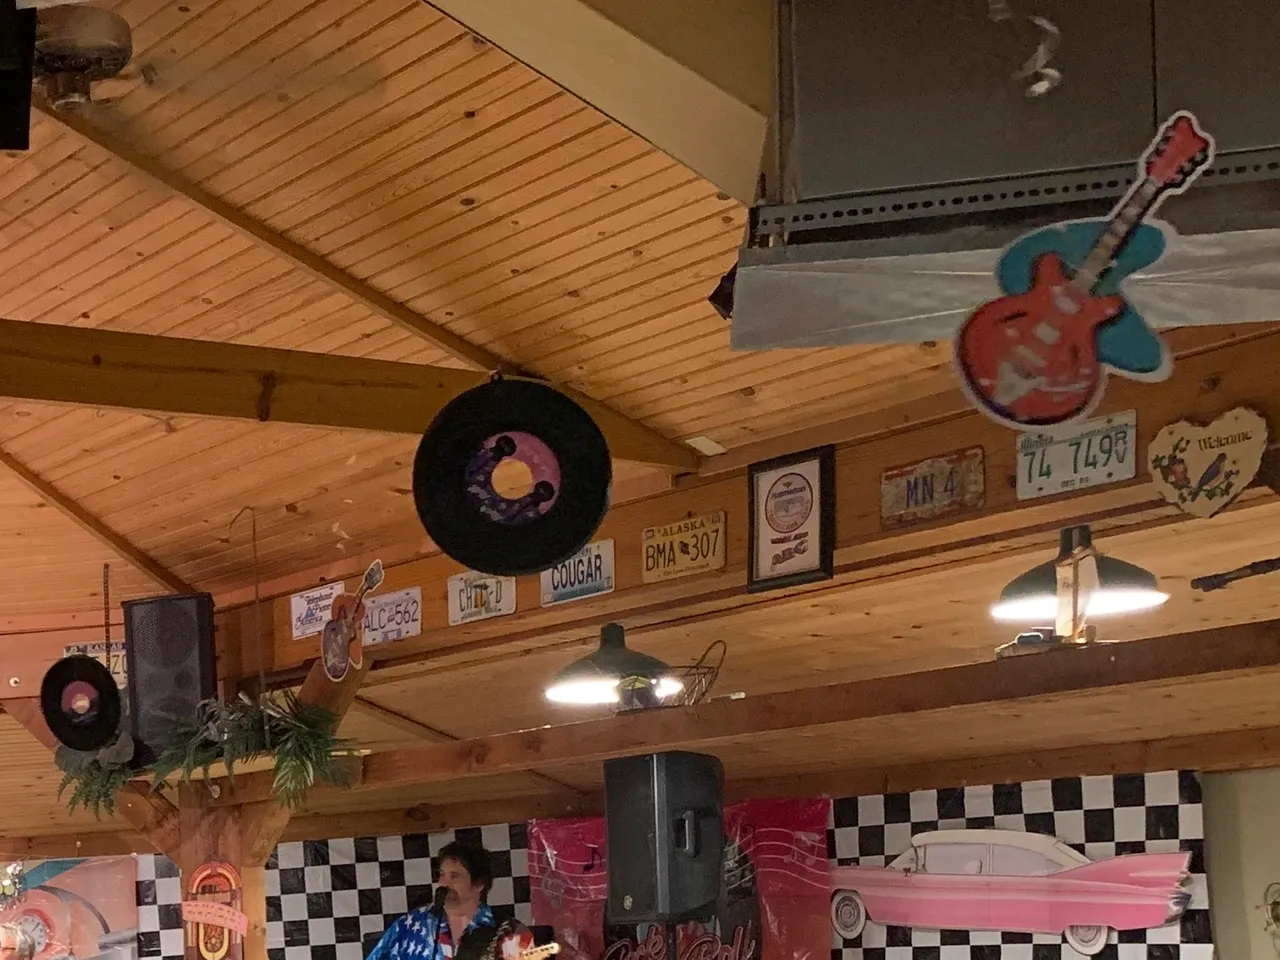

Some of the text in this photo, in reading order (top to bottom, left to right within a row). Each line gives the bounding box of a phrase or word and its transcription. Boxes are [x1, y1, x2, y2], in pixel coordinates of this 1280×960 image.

[1197, 429, 1253, 451] Welcome
[1023, 448, 1052, 484] 74
[906, 473, 933, 508] MN
[661, 519, 706, 538] ALASKA
[645, 528, 720, 572] BMA 307
[551, 553, 603, 592] COUGAR
[394, 600, 419, 625] 562
